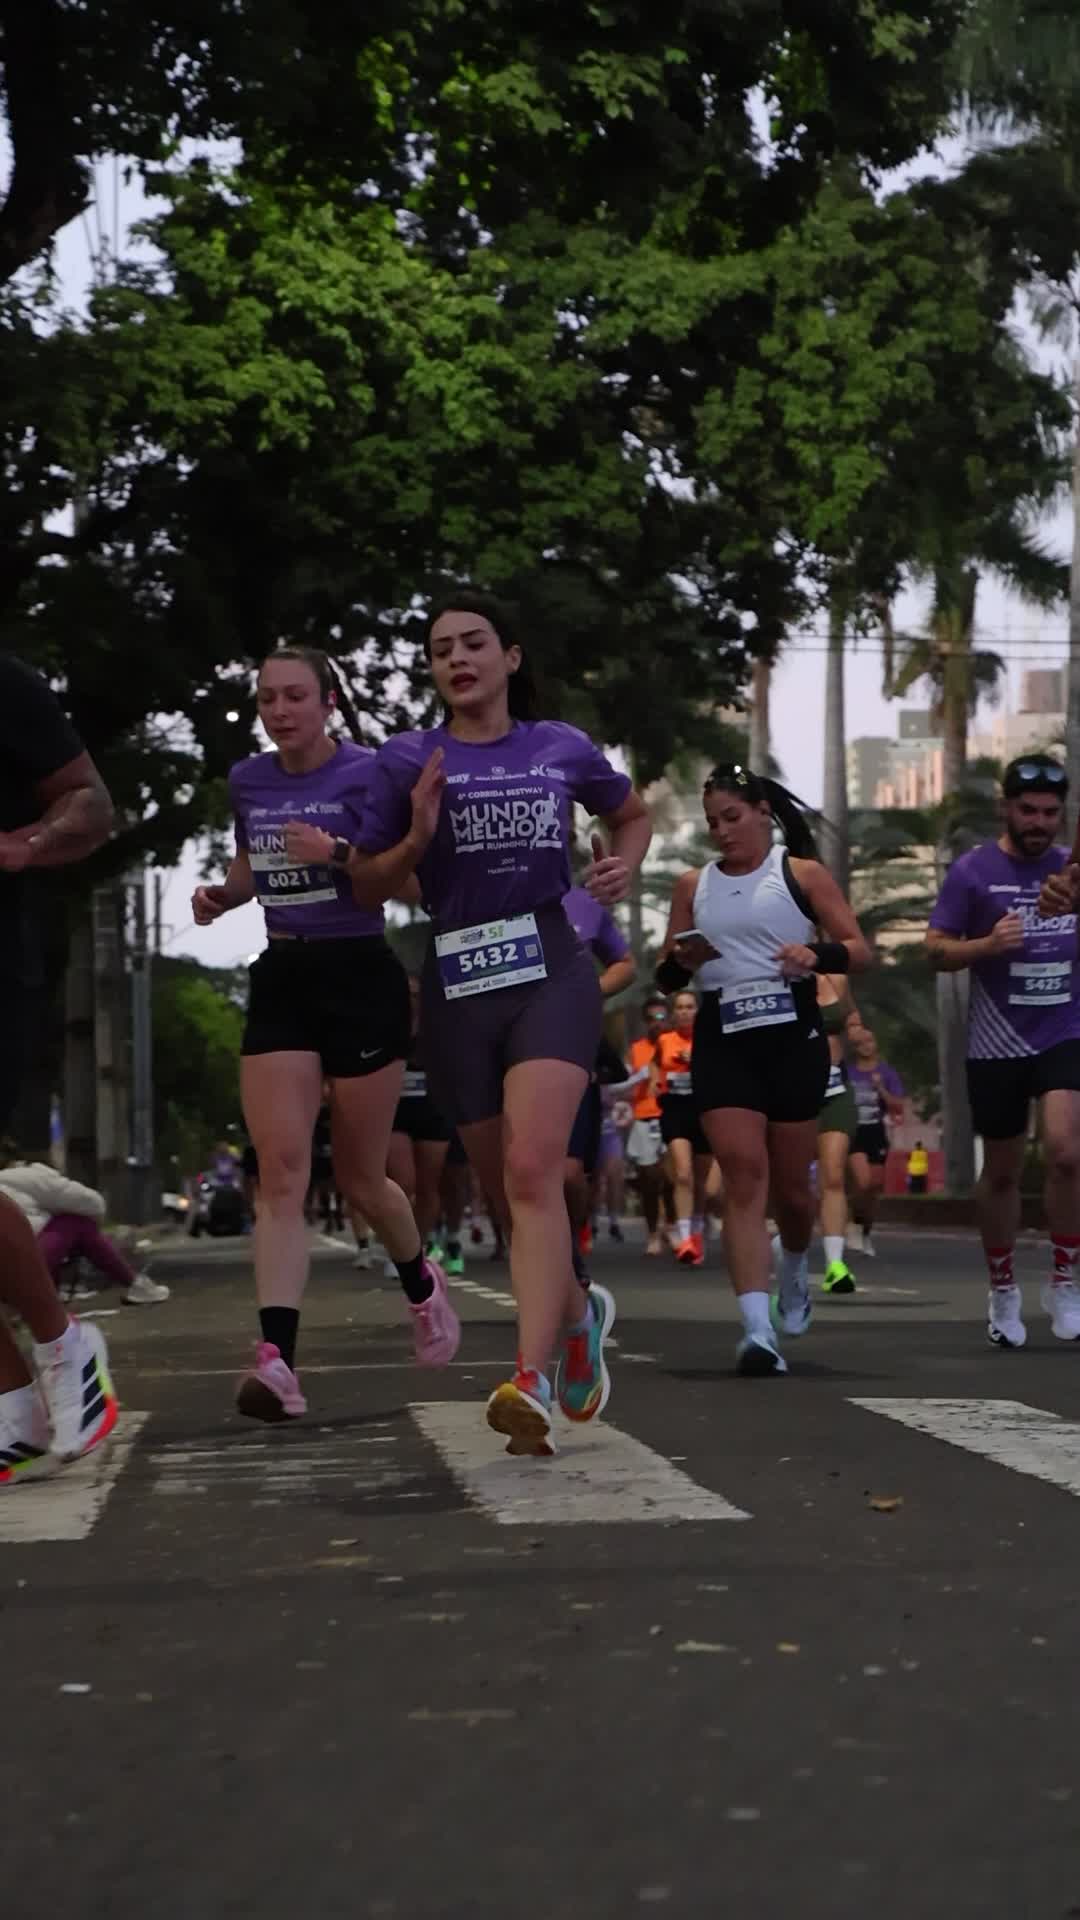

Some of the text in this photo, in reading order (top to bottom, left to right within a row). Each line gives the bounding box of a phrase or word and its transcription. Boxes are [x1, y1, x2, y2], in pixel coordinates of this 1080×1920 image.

[506, 786, 543, 797] BESTWAY
[449, 799, 549, 830] MUNDO
[248, 833, 286, 853] MUN
[268, 870, 311, 888] 6021
[458, 943, 519, 974] 5432
[1024, 977, 1063, 992] 5425
[735, 996, 777, 1015] 5665
